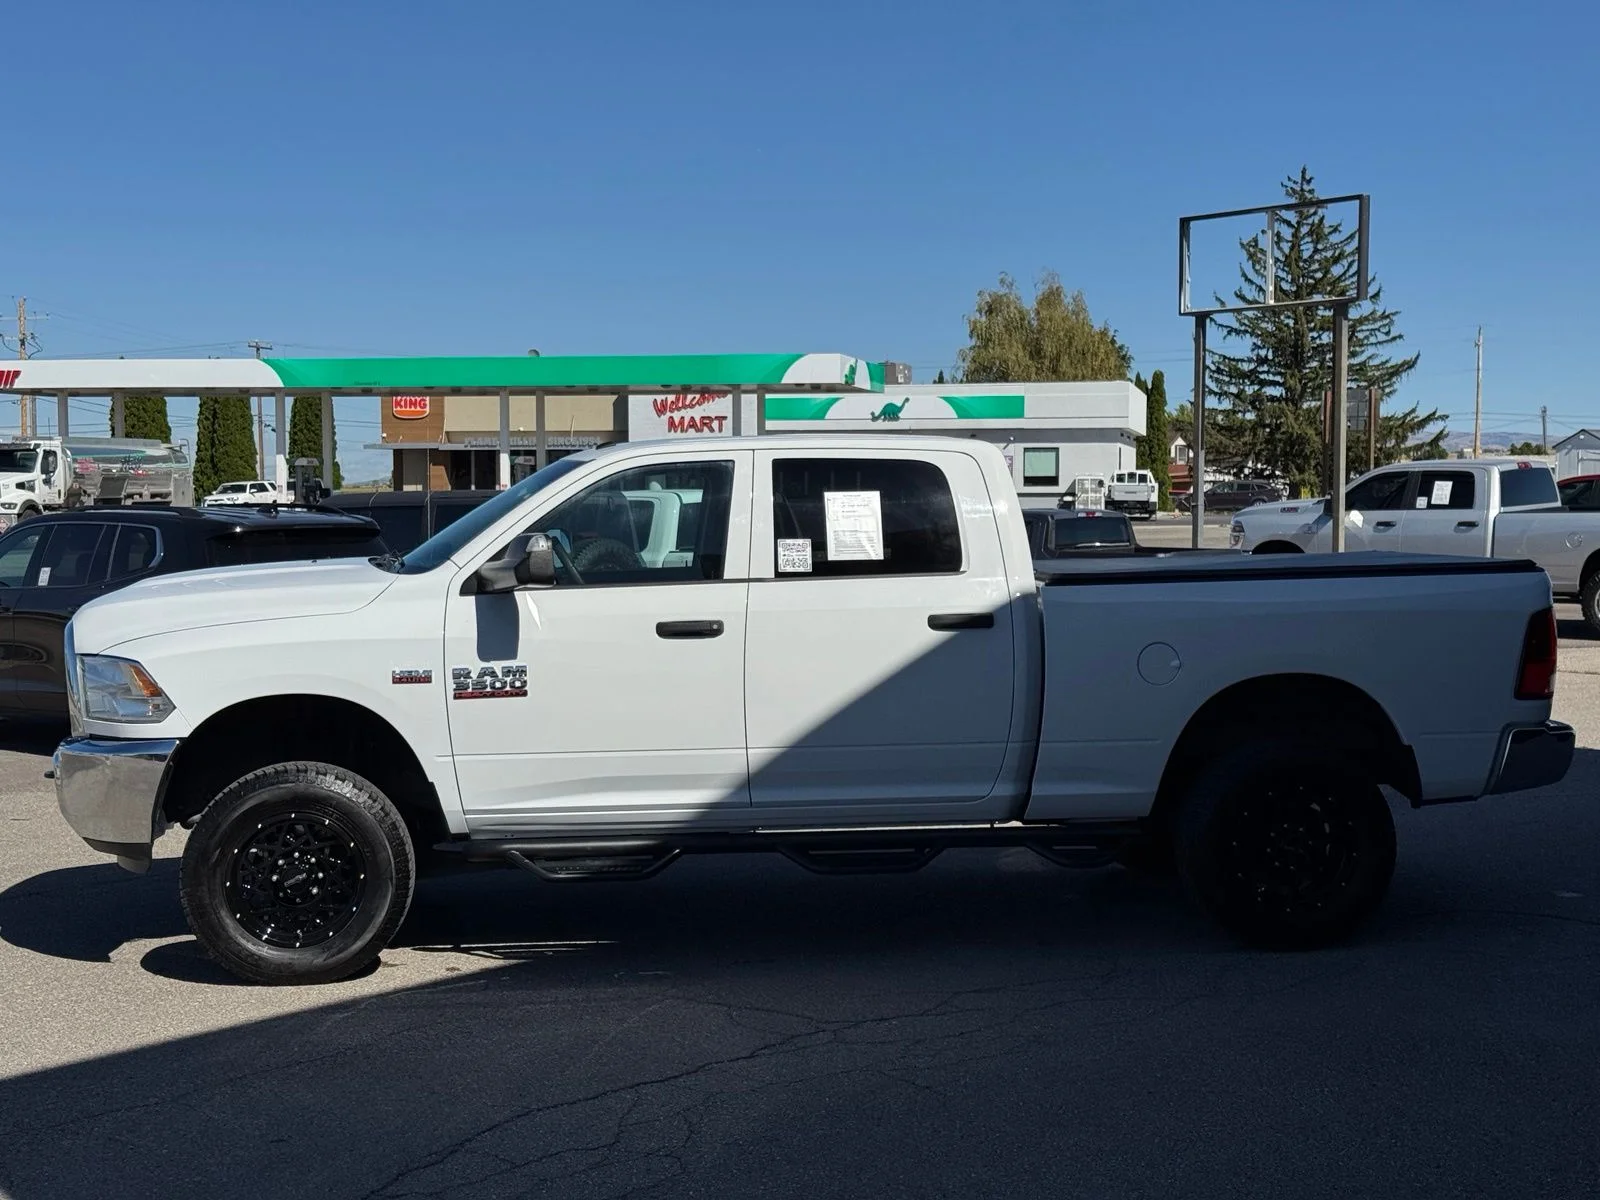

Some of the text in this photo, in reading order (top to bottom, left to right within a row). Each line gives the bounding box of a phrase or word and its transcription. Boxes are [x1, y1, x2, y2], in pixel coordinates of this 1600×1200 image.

[394, 398, 428, 410] KING
[667, 416, 728, 433] MART
[452, 665, 527, 680] RAM
[453, 678, 527, 692] 3500
[494, 689, 526, 697] DUTY
